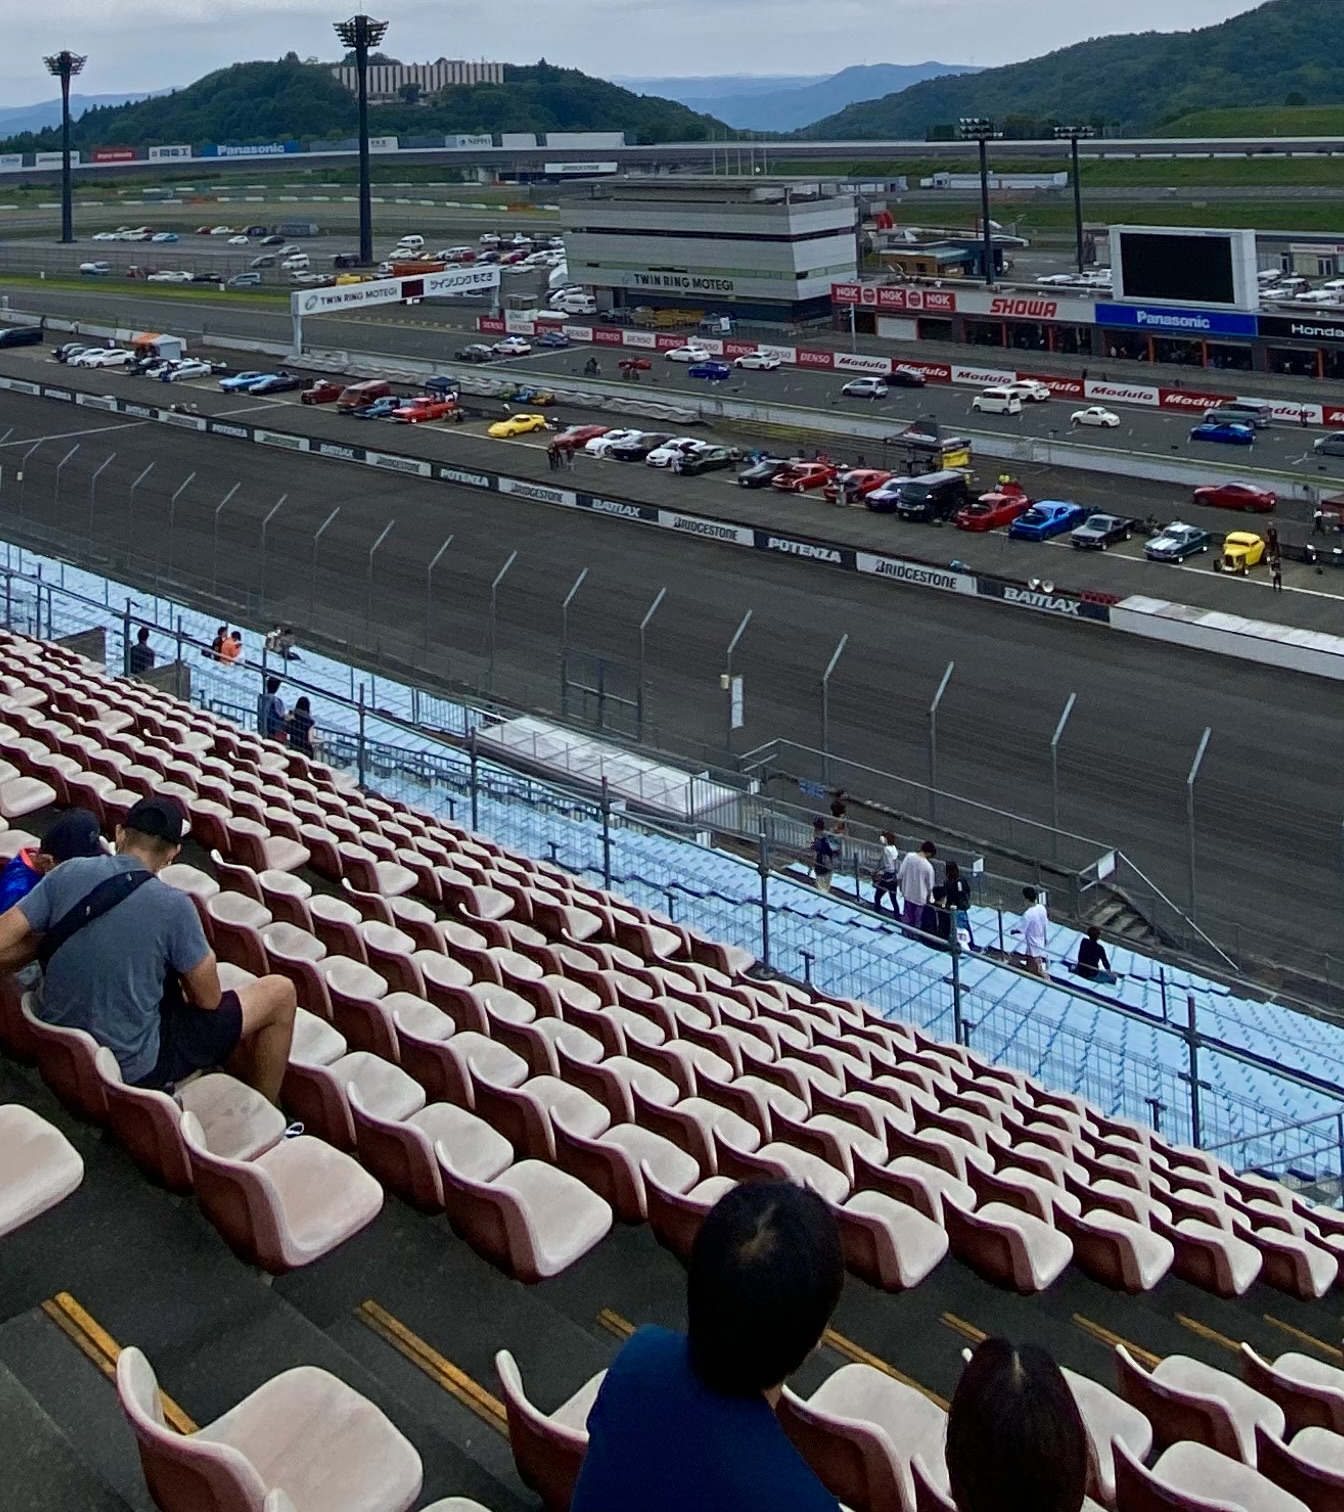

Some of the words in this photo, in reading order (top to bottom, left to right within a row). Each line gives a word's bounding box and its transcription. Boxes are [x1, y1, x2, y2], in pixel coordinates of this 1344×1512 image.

[217, 143, 285, 156] Panasonic
[430, 271, 494, 290] ツインリンクもてぎ
[634, 274, 661, 285] TWIN
[664, 276, 690, 287] RING
[692, 278, 734, 291] MOTEGI
[321, 295, 342, 306] TWIN
[344, 292, 364, 301] RING
[366, 287, 397, 299] MOTEGI
[836, 287, 858, 298] NGK
[880, 292, 903, 302] NGK
[926, 295, 950, 306] NGK
[990, 298, 1057, 318] SHOWA
[1137, 311, 1210, 329] Panasonic
[596, 332, 620, 341] DENSO
[1291, 324, 1344, 338] Honda
[626, 335, 652, 346] DENSO
[800, 352, 831, 364] DENSO
[839, 357, 888, 370] Modulo
[956, 371, 1012, 385] Modulo
[1090, 386, 1154, 401] Modulo
[1164, 394, 1222, 407] Modul
[440, 468, 489, 487] POTENZA
[512, 482, 564, 504] BRIDGESTONE
[674, 517, 739, 541] BRIDGESTONE
[768, 536, 842, 563] POTENZA
[875, 559, 958, 589] BRIDGESTONE
